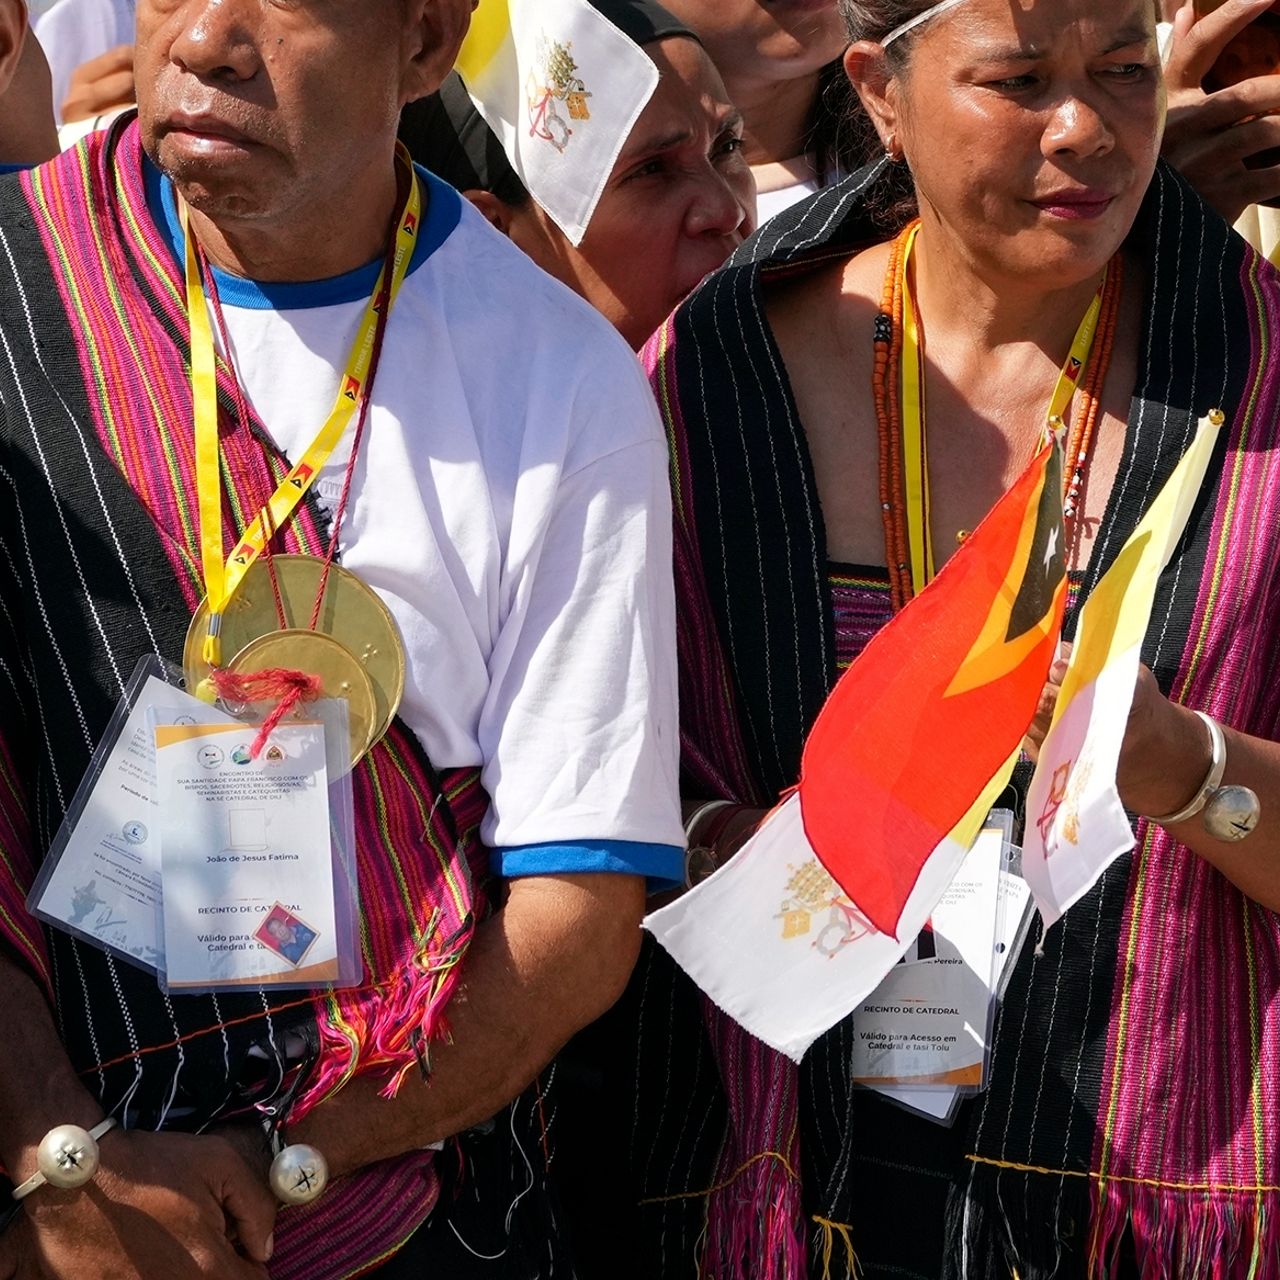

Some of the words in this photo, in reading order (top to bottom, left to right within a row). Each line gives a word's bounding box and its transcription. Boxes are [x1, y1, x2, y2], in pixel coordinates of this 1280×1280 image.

[206, 855, 226, 863] João
[242, 854, 267, 862] Jesus
[198, 906, 237, 914] RECINTO
[197, 934, 227, 942] Válido
[229, 934, 250, 943] para
[207, 943, 246, 952] Catedral
[916, 1007, 960, 1015] CATEDRAL
[860, 1031, 886, 1041] Válido
[889, 1034, 908, 1042] para
[910, 1033, 941, 1042] Acesso
[868, 1041, 903, 1051] Catedral
